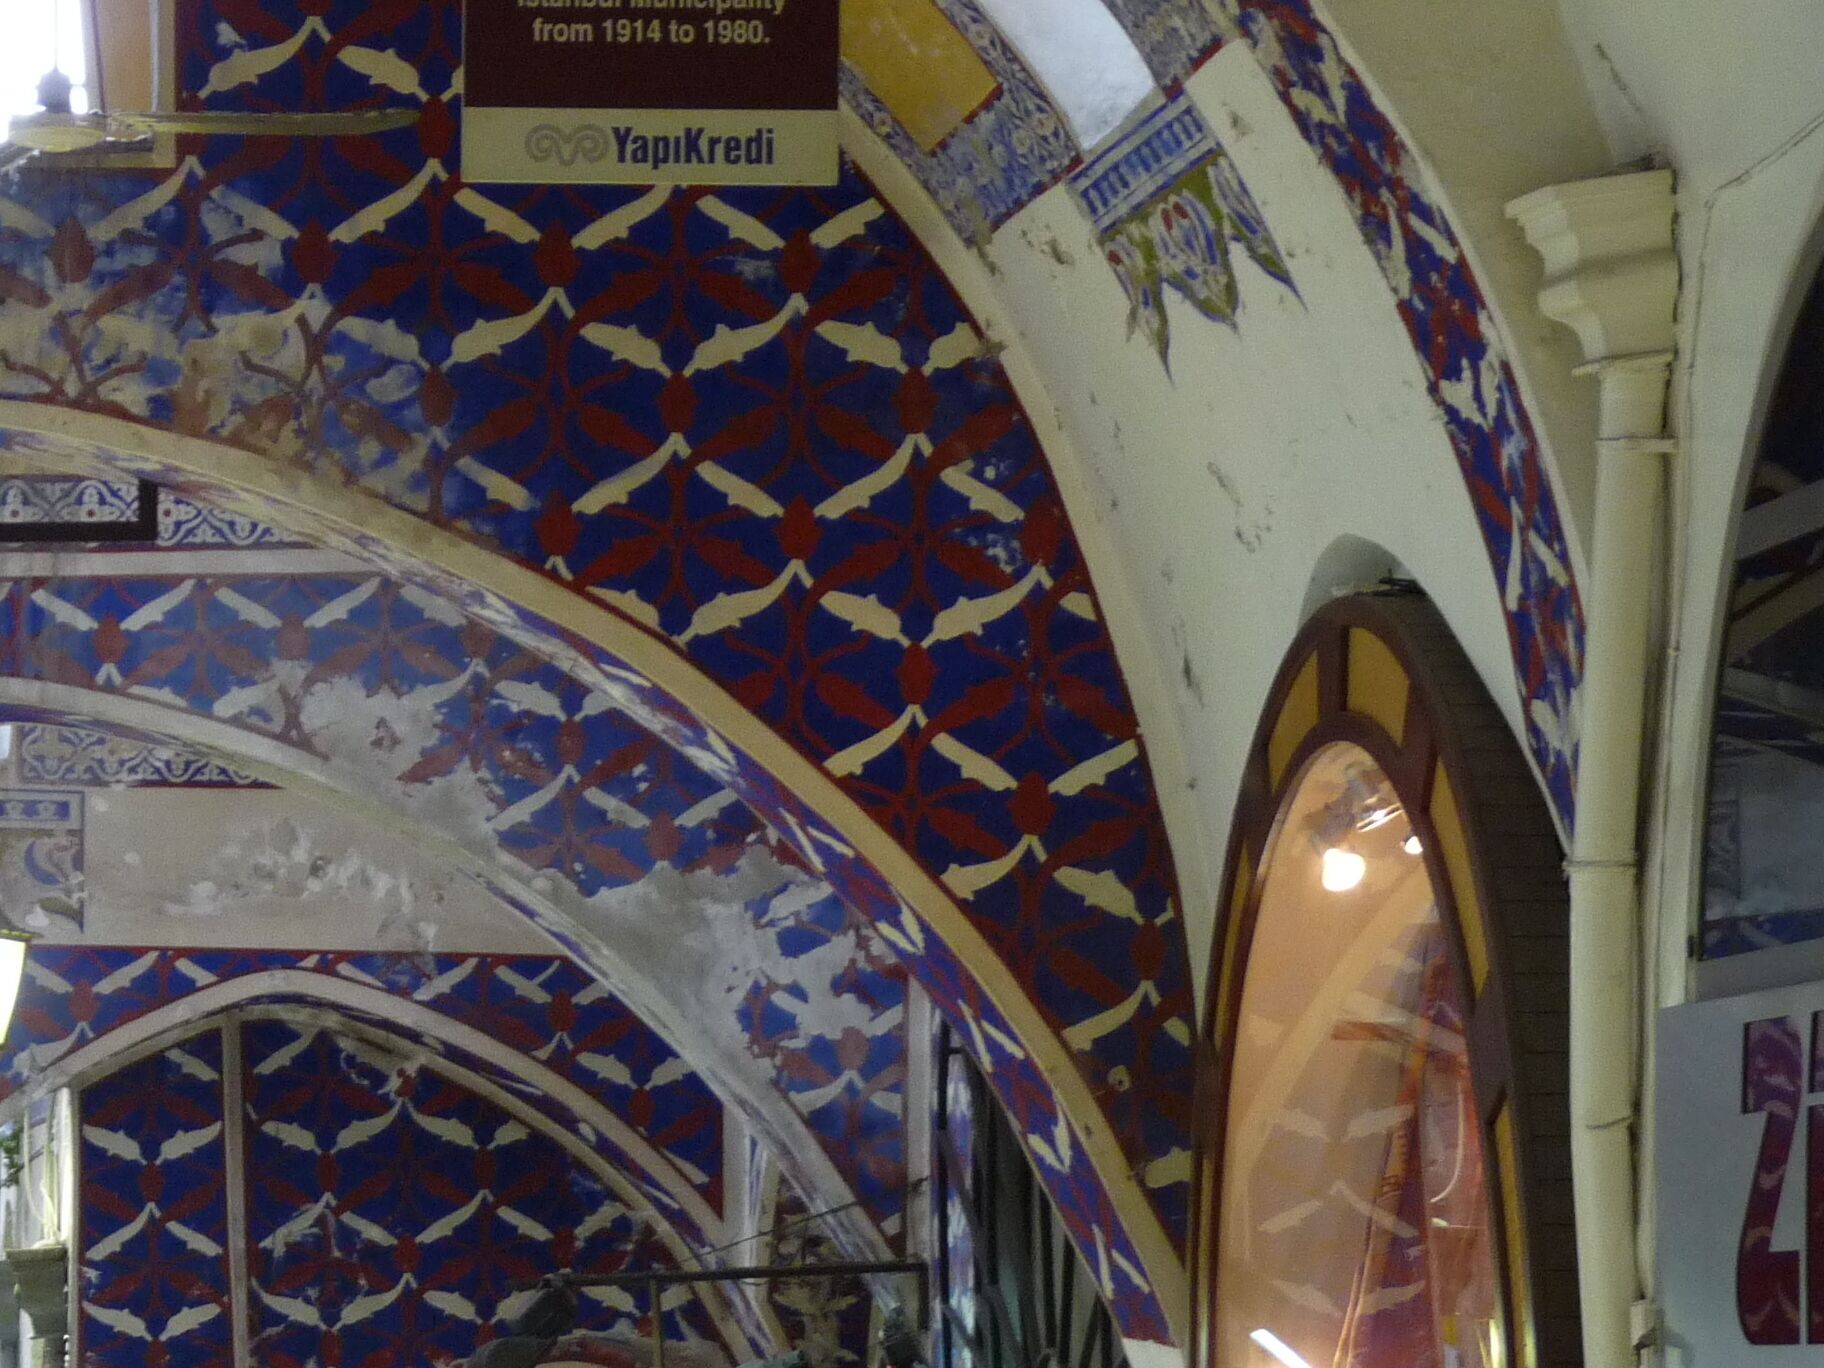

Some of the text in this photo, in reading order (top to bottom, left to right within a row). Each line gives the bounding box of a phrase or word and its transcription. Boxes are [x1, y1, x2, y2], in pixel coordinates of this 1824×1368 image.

[532, 17, 772, 44] from 1914 to 1980.
